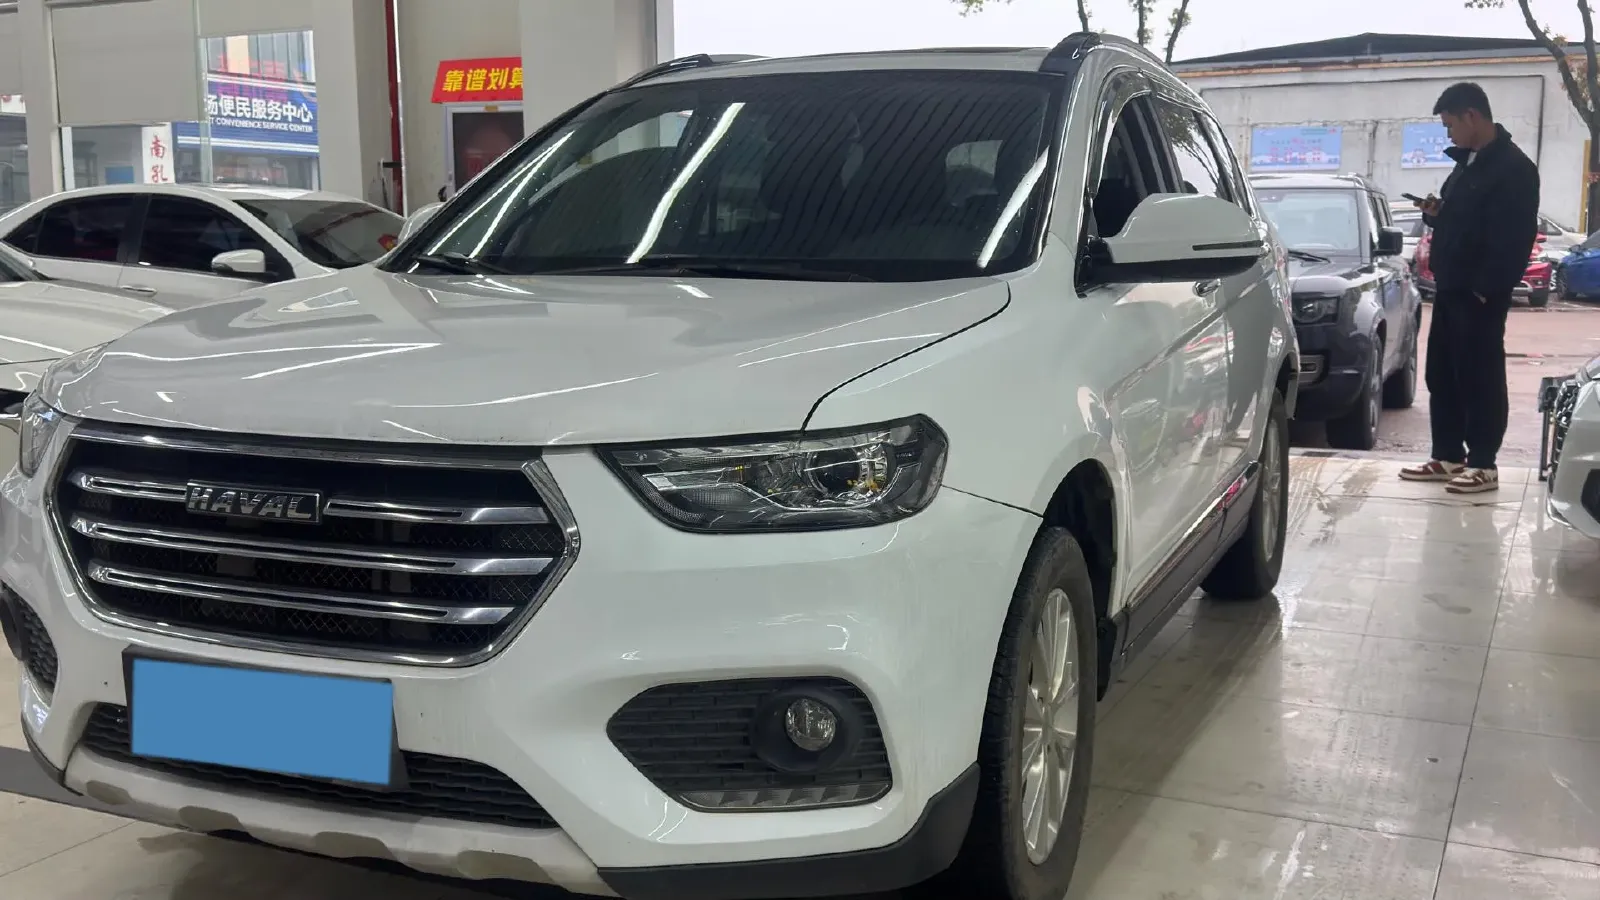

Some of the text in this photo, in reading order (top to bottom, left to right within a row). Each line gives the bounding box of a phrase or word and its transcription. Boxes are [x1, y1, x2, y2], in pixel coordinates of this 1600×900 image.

[263, 121, 288, 131] SERVICE
[289, 124, 313, 133] CENTER
[187, 487, 312, 519] HAVAL
